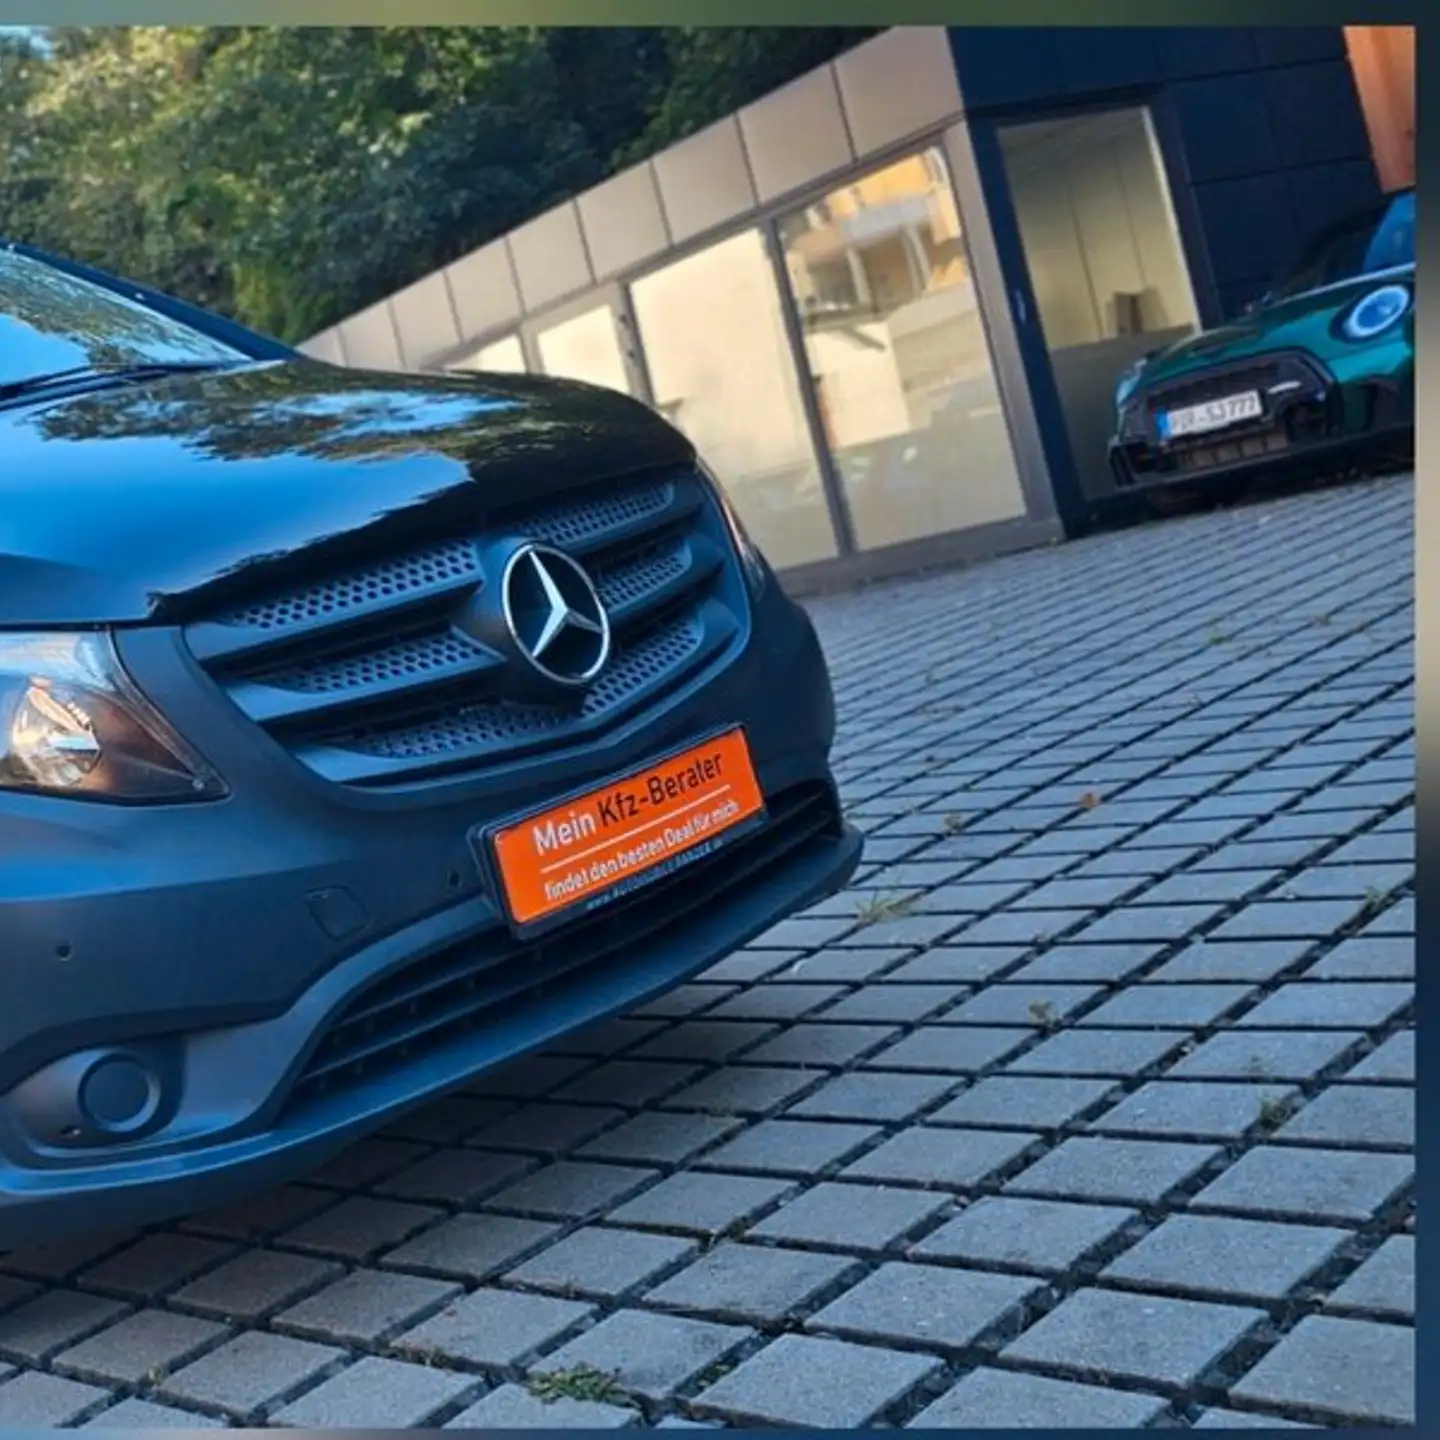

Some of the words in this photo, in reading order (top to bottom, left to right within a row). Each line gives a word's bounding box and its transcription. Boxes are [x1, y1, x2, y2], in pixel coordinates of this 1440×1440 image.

[532, 809, 597, 856] Mein
[596, 753, 723, 827] Kfz-Berater
[544, 864, 588, 901] findet
[589, 856, 619, 881] den
[617, 836, 666, 869] besten
[663, 818, 694, 849] Deal
